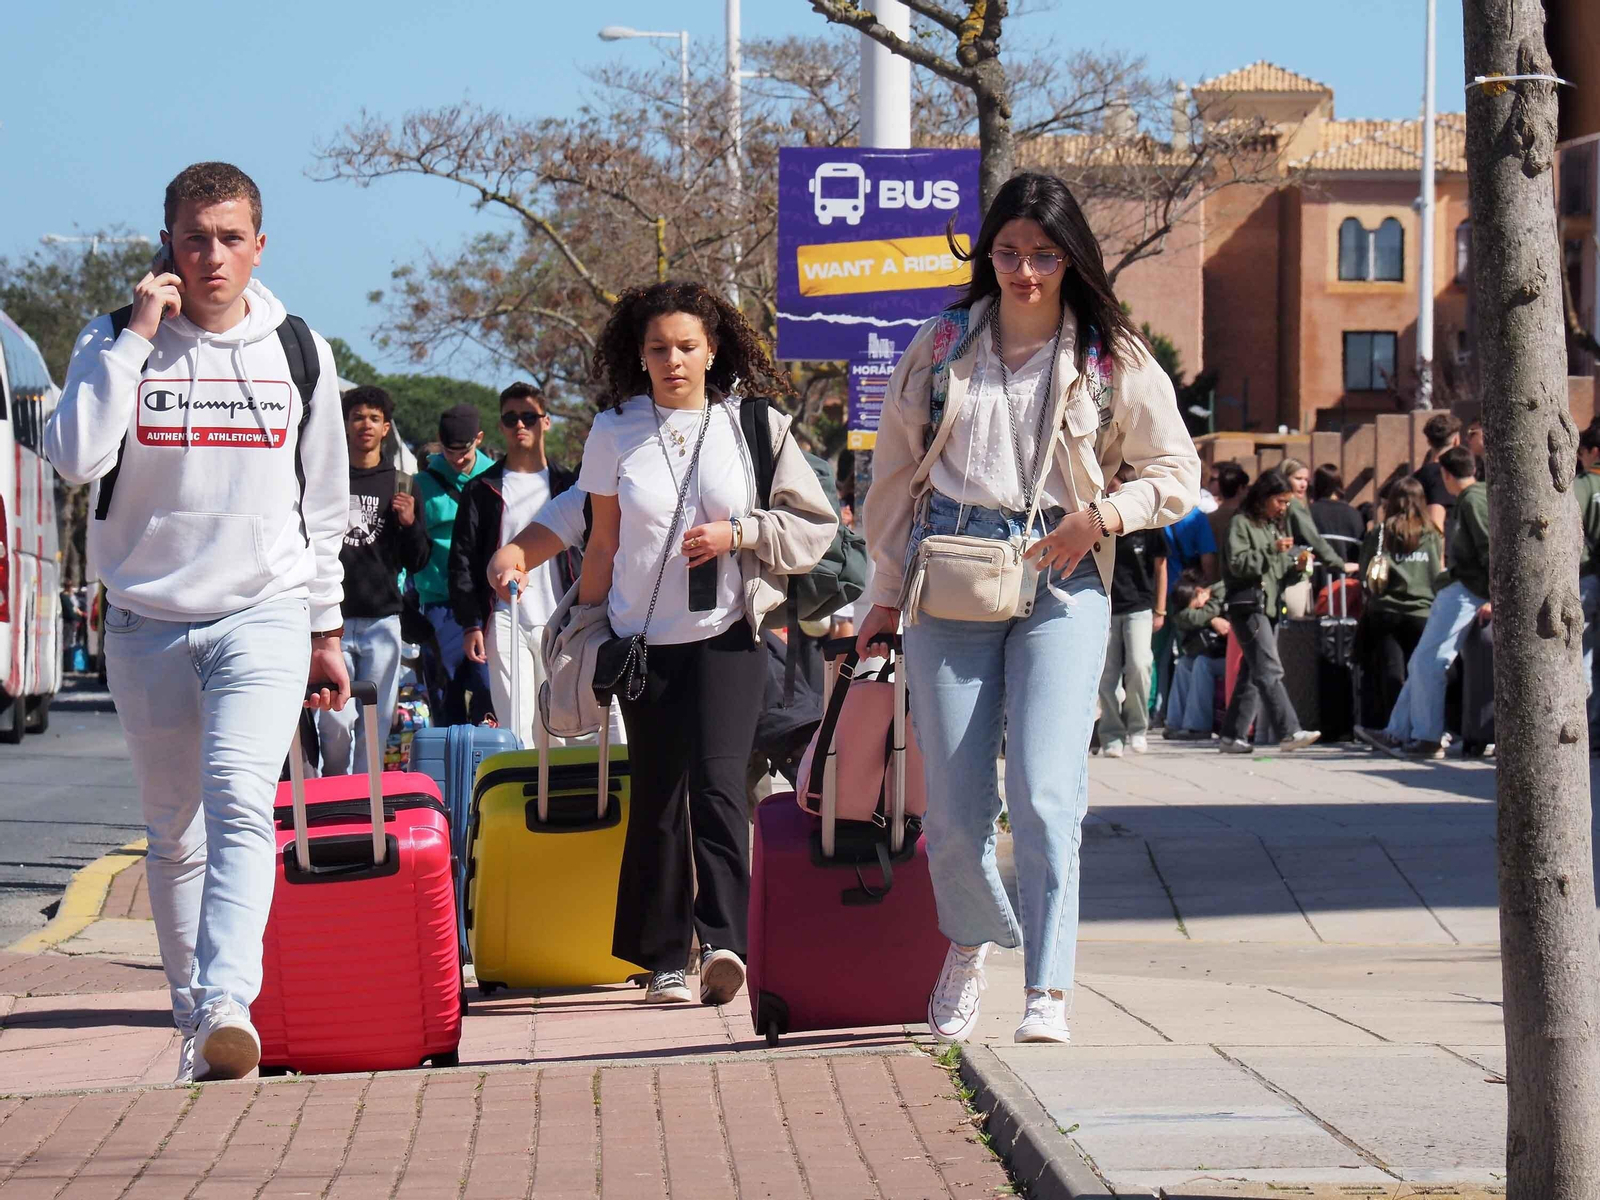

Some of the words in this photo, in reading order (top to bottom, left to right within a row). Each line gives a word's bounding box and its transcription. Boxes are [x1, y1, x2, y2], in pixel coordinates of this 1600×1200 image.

[878, 179, 960, 210] BUS
[803, 259, 875, 280] WANT
[881, 258, 897, 275] A
[144, 389, 286, 419] Champion
[146, 431, 200, 441] AUTHENIC
[361, 495, 379, 506] YOU
